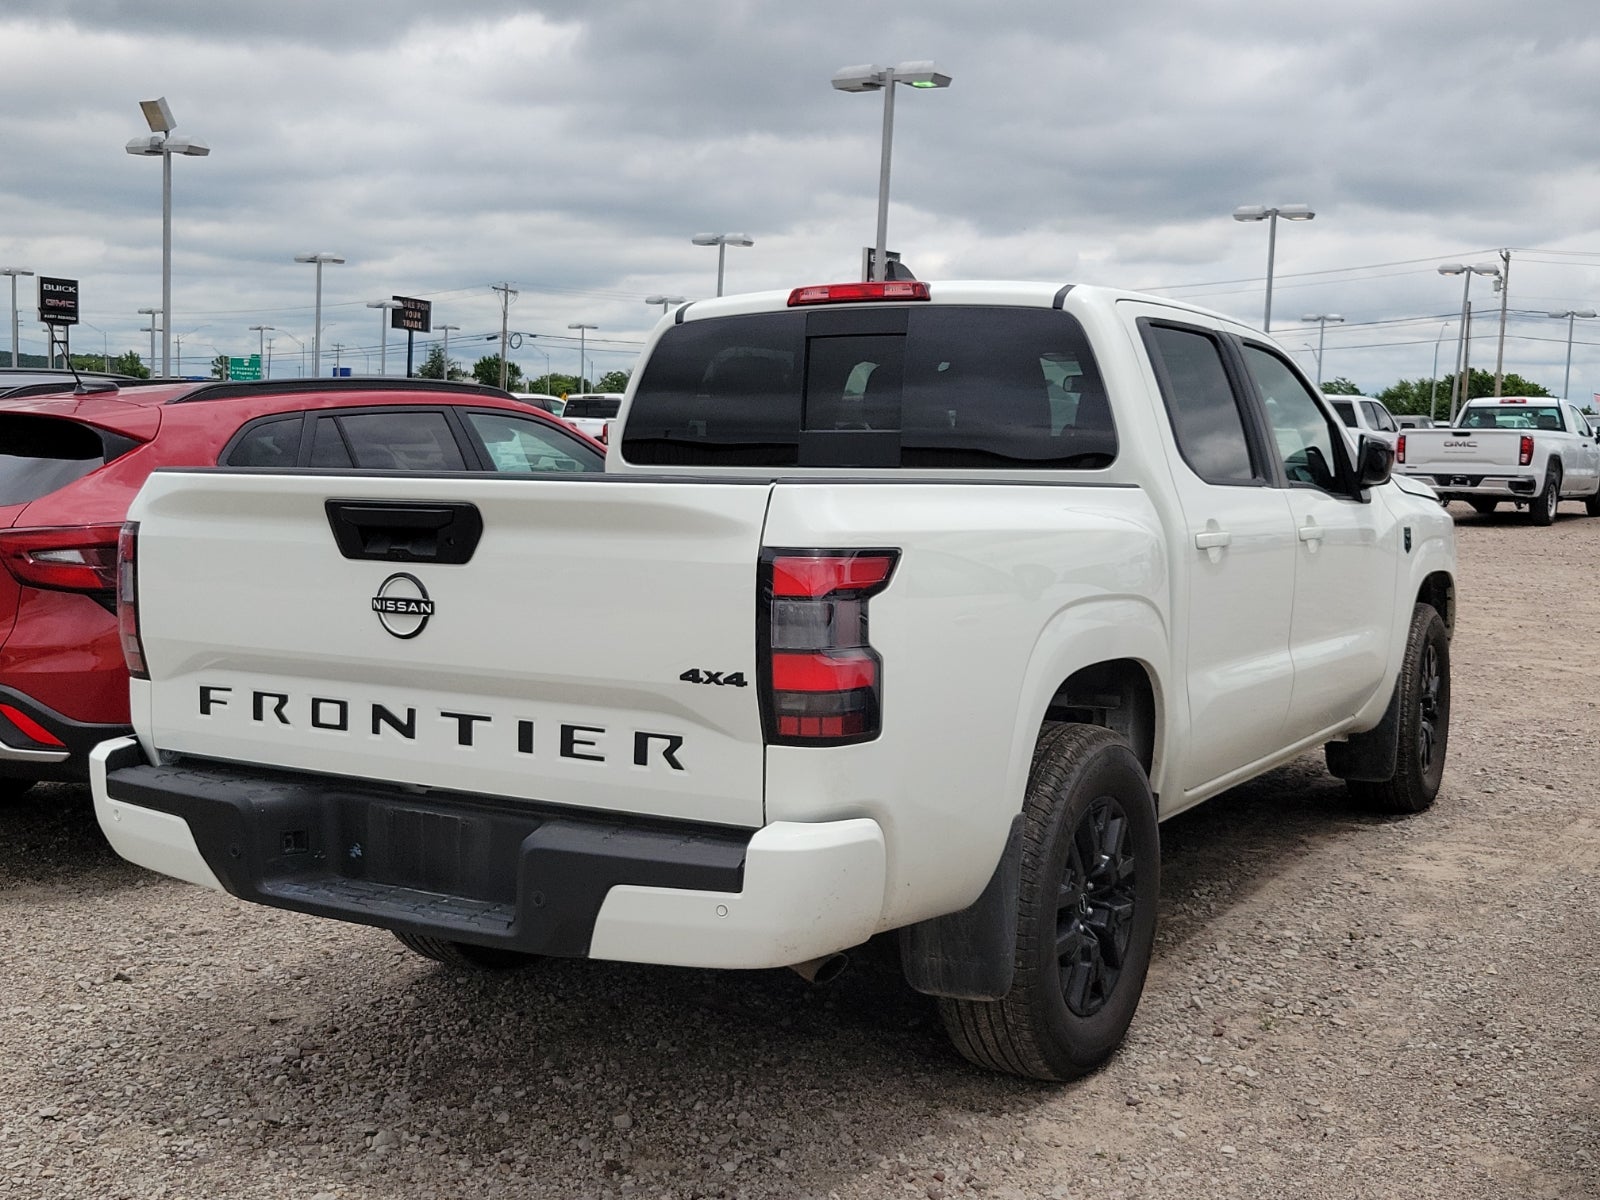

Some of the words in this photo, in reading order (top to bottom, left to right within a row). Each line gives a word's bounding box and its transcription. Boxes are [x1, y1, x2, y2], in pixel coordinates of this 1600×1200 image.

[43, 283, 77, 293] BUICK
[45, 298, 76, 308] GMC
[403, 319, 423, 329] TRADE
[373, 599, 432, 613] NISSAN
[199, 685, 685, 770] FRONTIER
